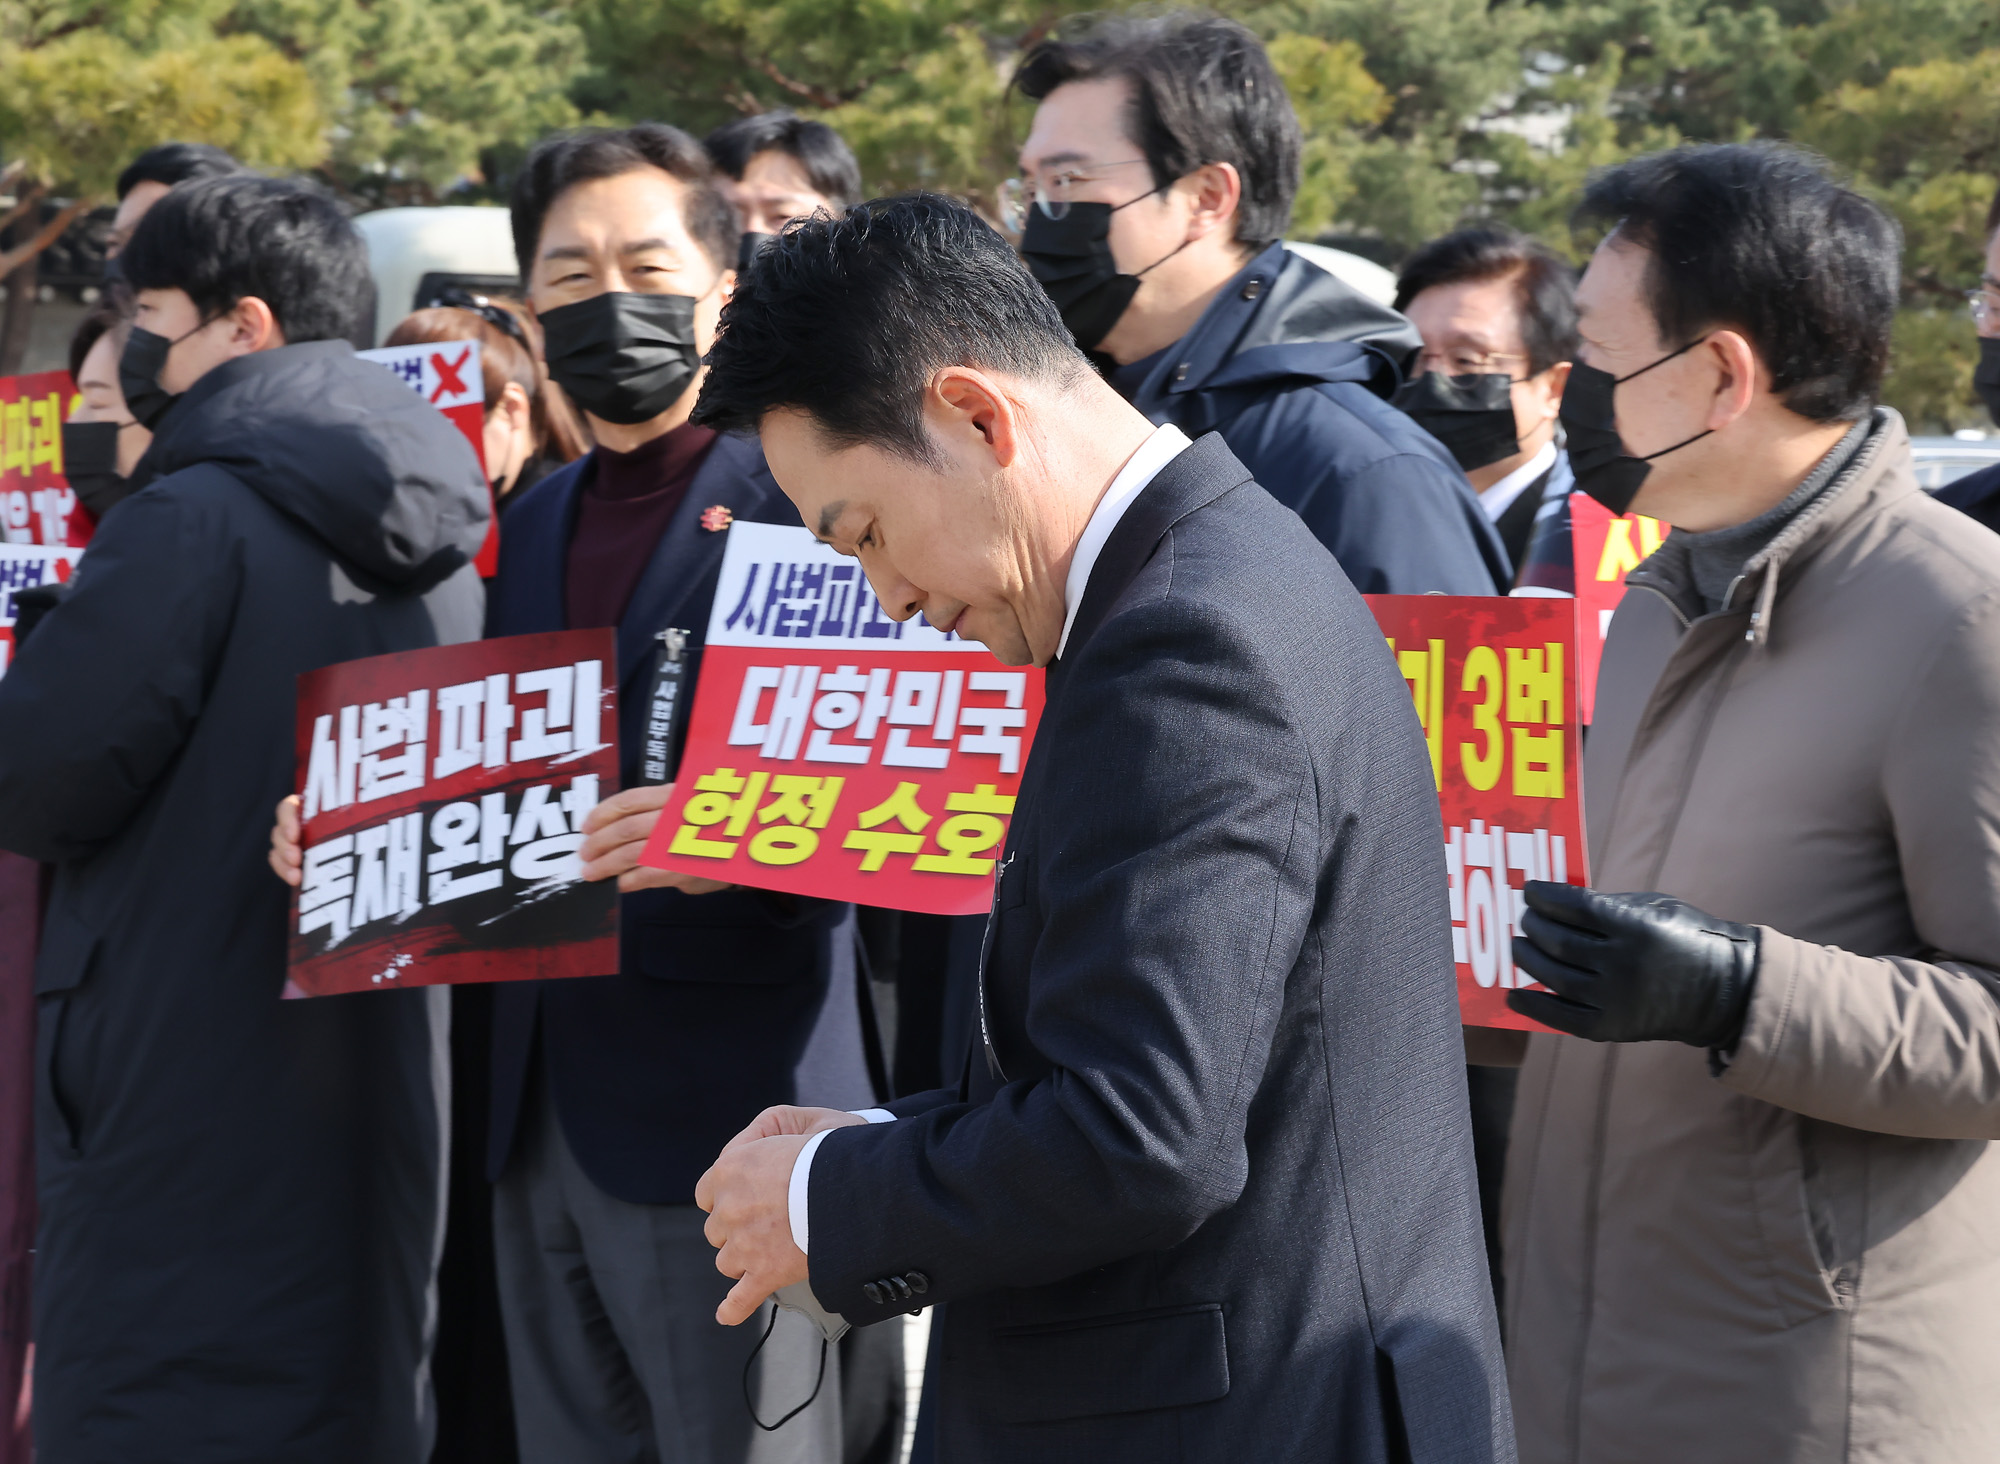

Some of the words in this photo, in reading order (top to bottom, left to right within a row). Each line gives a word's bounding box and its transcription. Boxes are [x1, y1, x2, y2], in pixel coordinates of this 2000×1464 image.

[0, 392, 61, 477] 파괴
[303, 689, 429, 821] 사법
[433, 660, 604, 780] 파괴
[728, 665, 1027, 774] 대한민국
[299, 812, 424, 946] 독재
[427, 774, 600, 905] 완성
[668, 768, 846, 866] 헌정
[842, 781, 1017, 877] 수호
